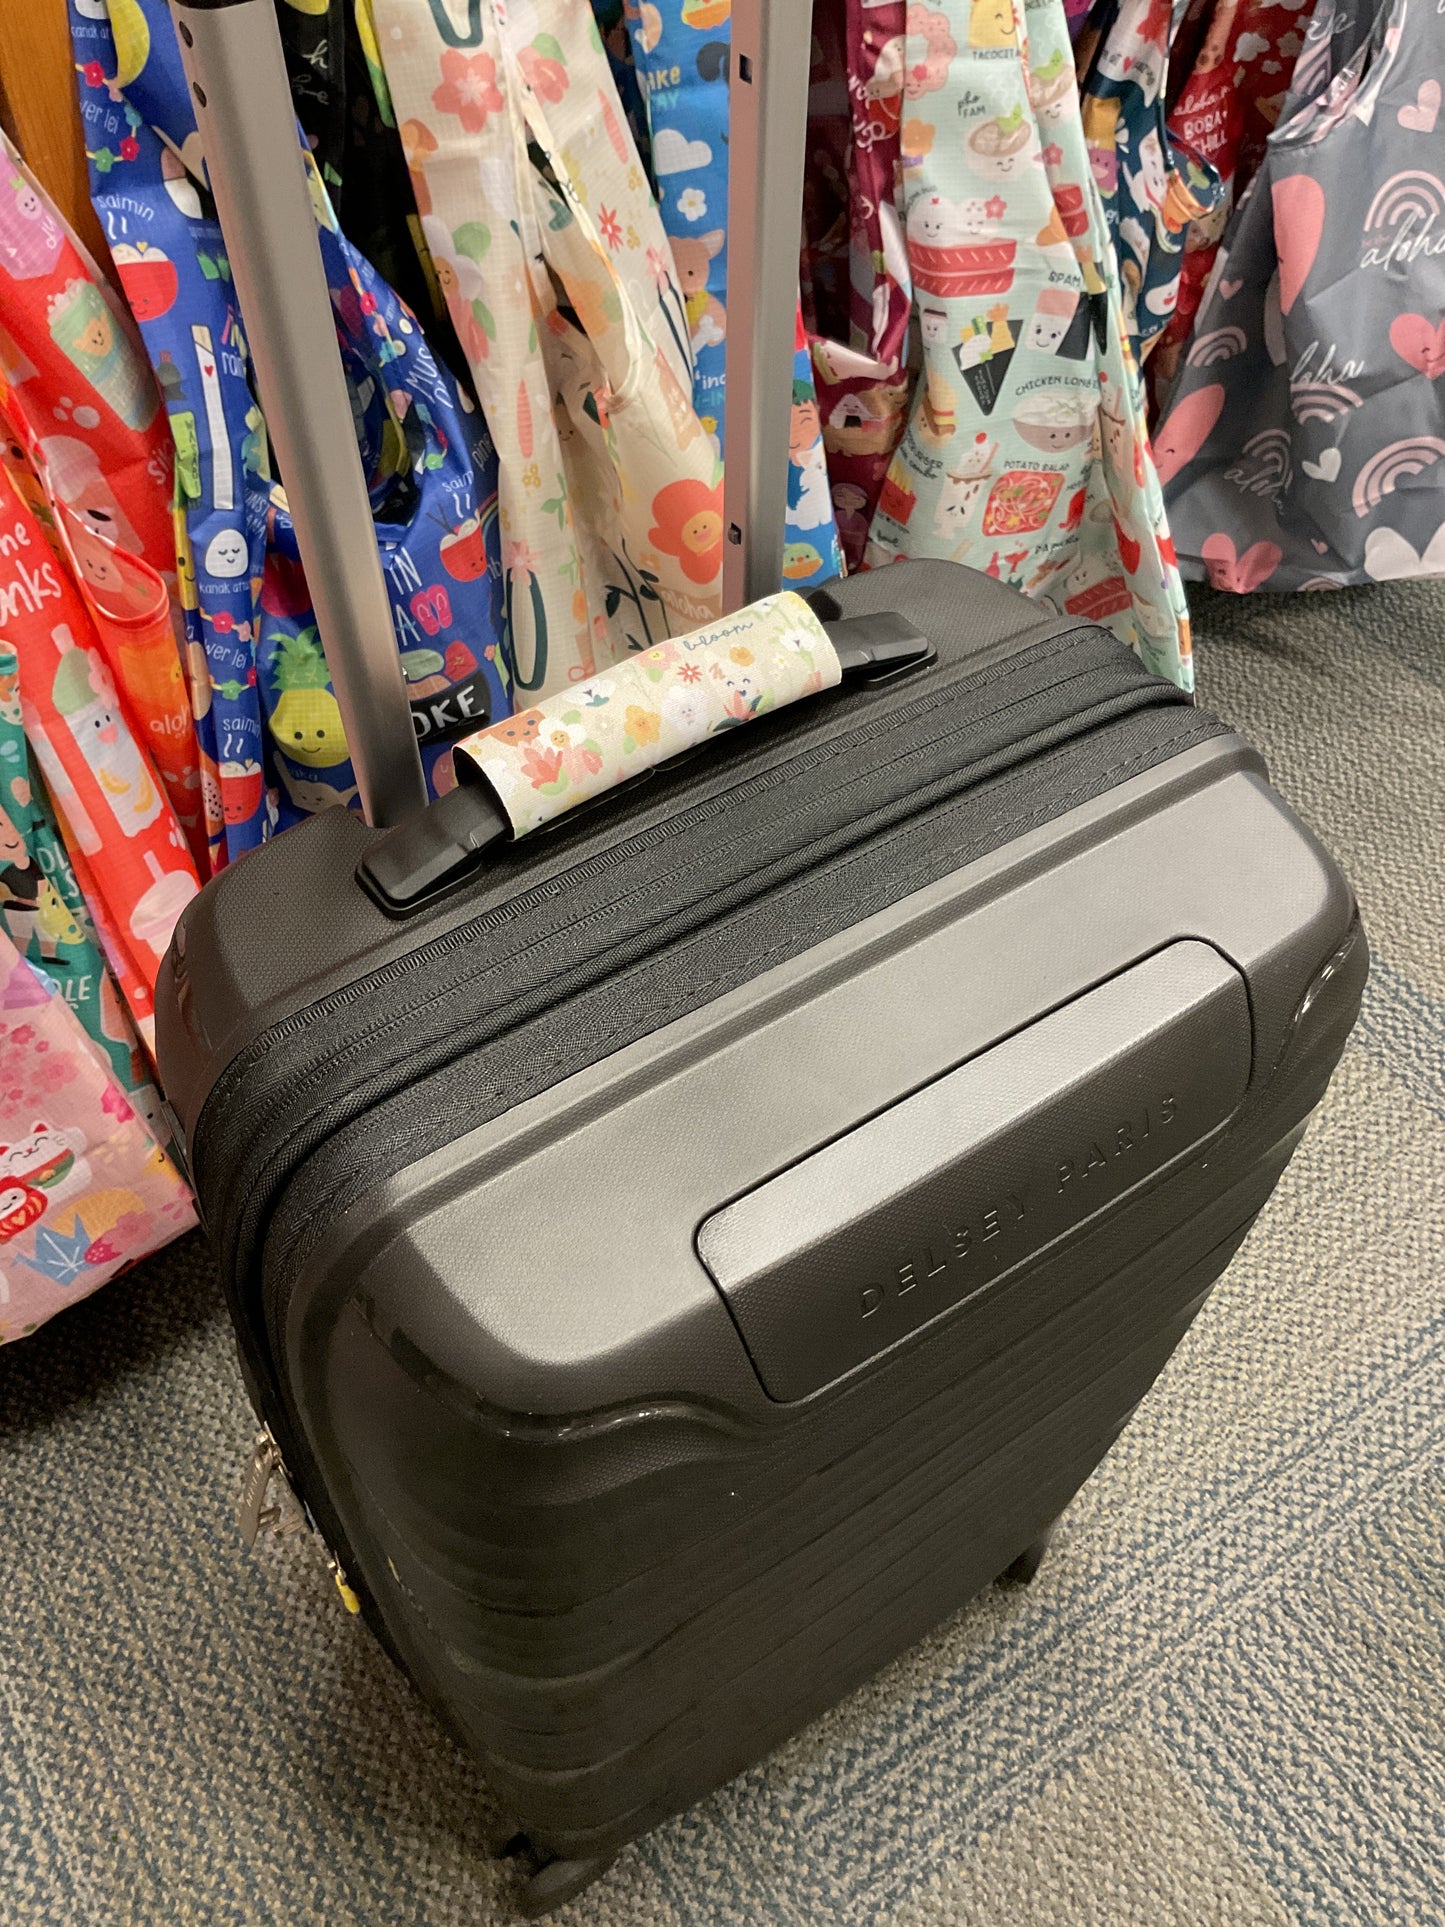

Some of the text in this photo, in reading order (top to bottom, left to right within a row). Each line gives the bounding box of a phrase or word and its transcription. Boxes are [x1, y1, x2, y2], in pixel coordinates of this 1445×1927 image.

[96, 193, 155, 221] saimin
[1048, 270, 1081, 287] SPAM
[1015, 375, 1062, 396] CHICKEN
[1004, 460, 1040, 470] POTATO
[683, 622, 754, 651] bloom
[231, 649, 248, 669] lei
[861, 1098, 1176, 1318] DELSEY PARIS
